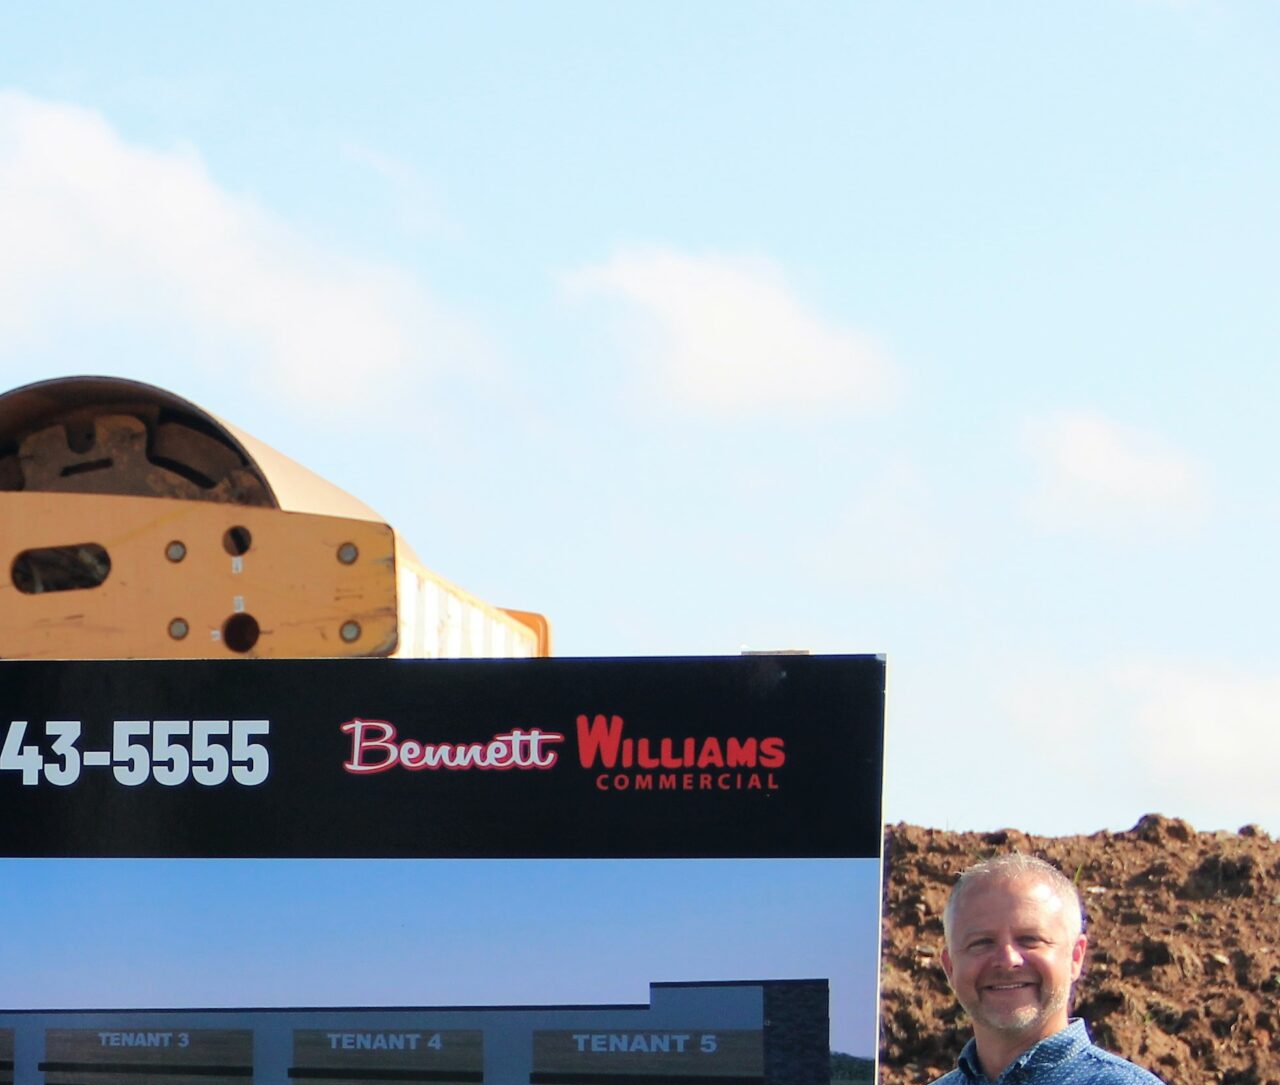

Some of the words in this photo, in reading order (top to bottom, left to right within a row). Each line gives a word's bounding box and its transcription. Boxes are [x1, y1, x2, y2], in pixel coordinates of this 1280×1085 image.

[340, 717, 565, 774] Bennett
[576, 714, 786, 768] WILLIAMS
[596, 773, 780, 790] COMMERCIAL
[99, 1032, 173, 1047] TENANT
[177, 1033, 190, 1047] 3
[327, 1033, 420, 1050] TENANT
[427, 1034, 443, 1050] 4
[572, 1034, 690, 1053] TENANT
[700, 1035, 718, 1053] 5
